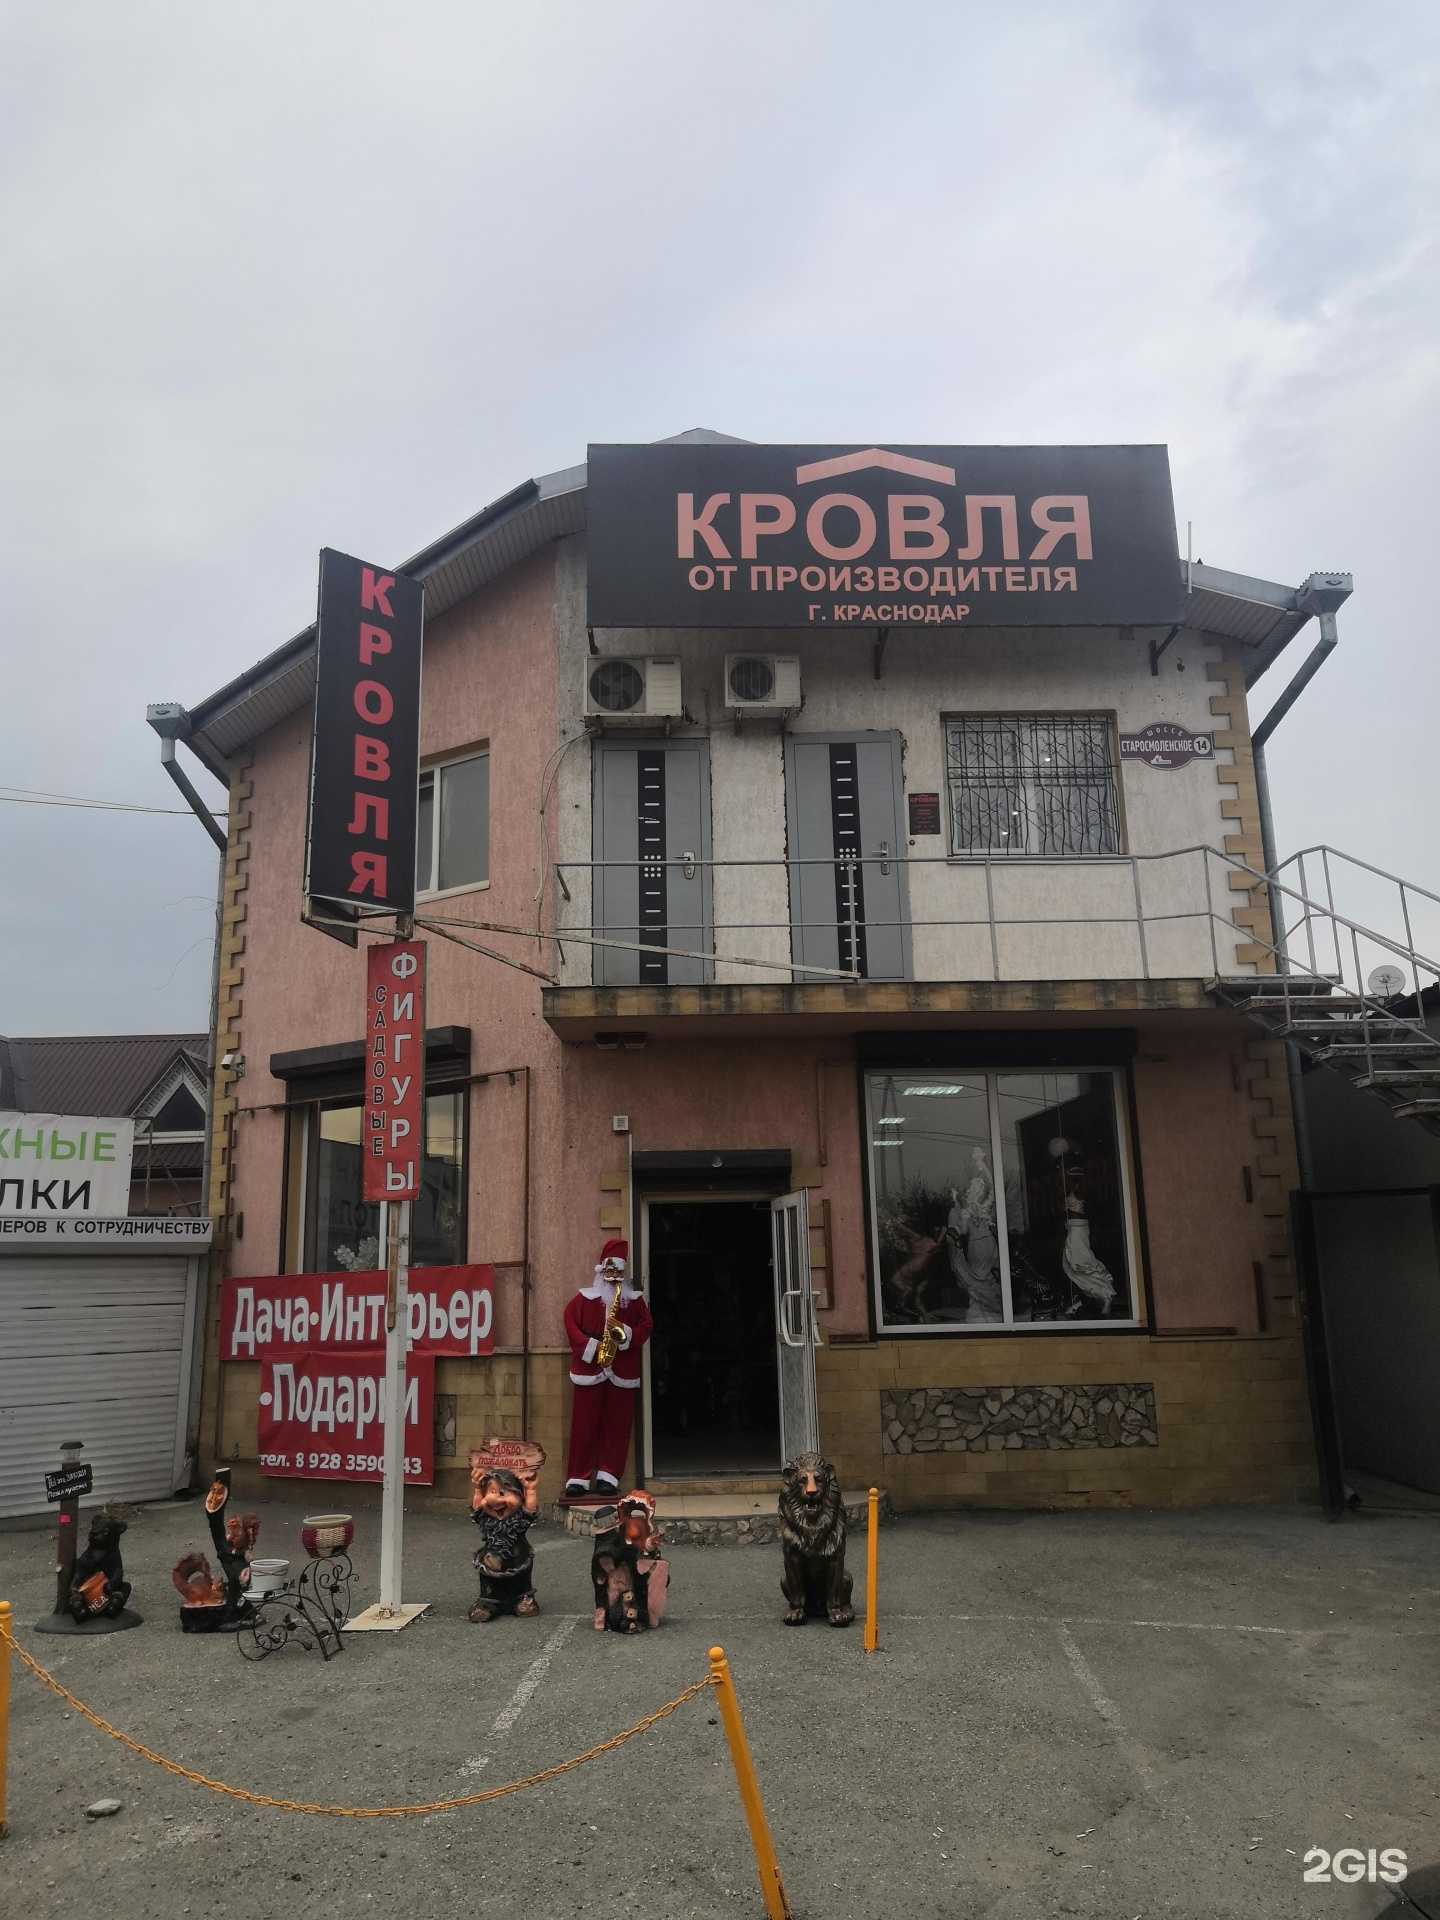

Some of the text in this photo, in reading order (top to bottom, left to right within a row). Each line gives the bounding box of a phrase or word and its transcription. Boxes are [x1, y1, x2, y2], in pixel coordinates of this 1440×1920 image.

[677, 493, 1094, 560] КРОВЛЯ
[688, 566, 1078, 596] ОТ ПРОИЗВОДИТЕЛЯ
[808, 604, 970, 623] Г. КРАСНОДАР
[348, 566, 396, 897] КРОВЛЯ
[1121, 740, 1208, 752] СТАРОСМОЛЕНСКОЕ 14
[371, 985, 386, 1156] САДОВЫЕ
[386, 952, 418, 1191] ФИГУРЫ
[0, 1221, 210, 1236] ЕРОВ К СОТРУДНИЧЕСТВУ
[320, 1283, 493, 1356] Интрьер
[258, 1452, 422, 1474] тел. 8 928 359043
